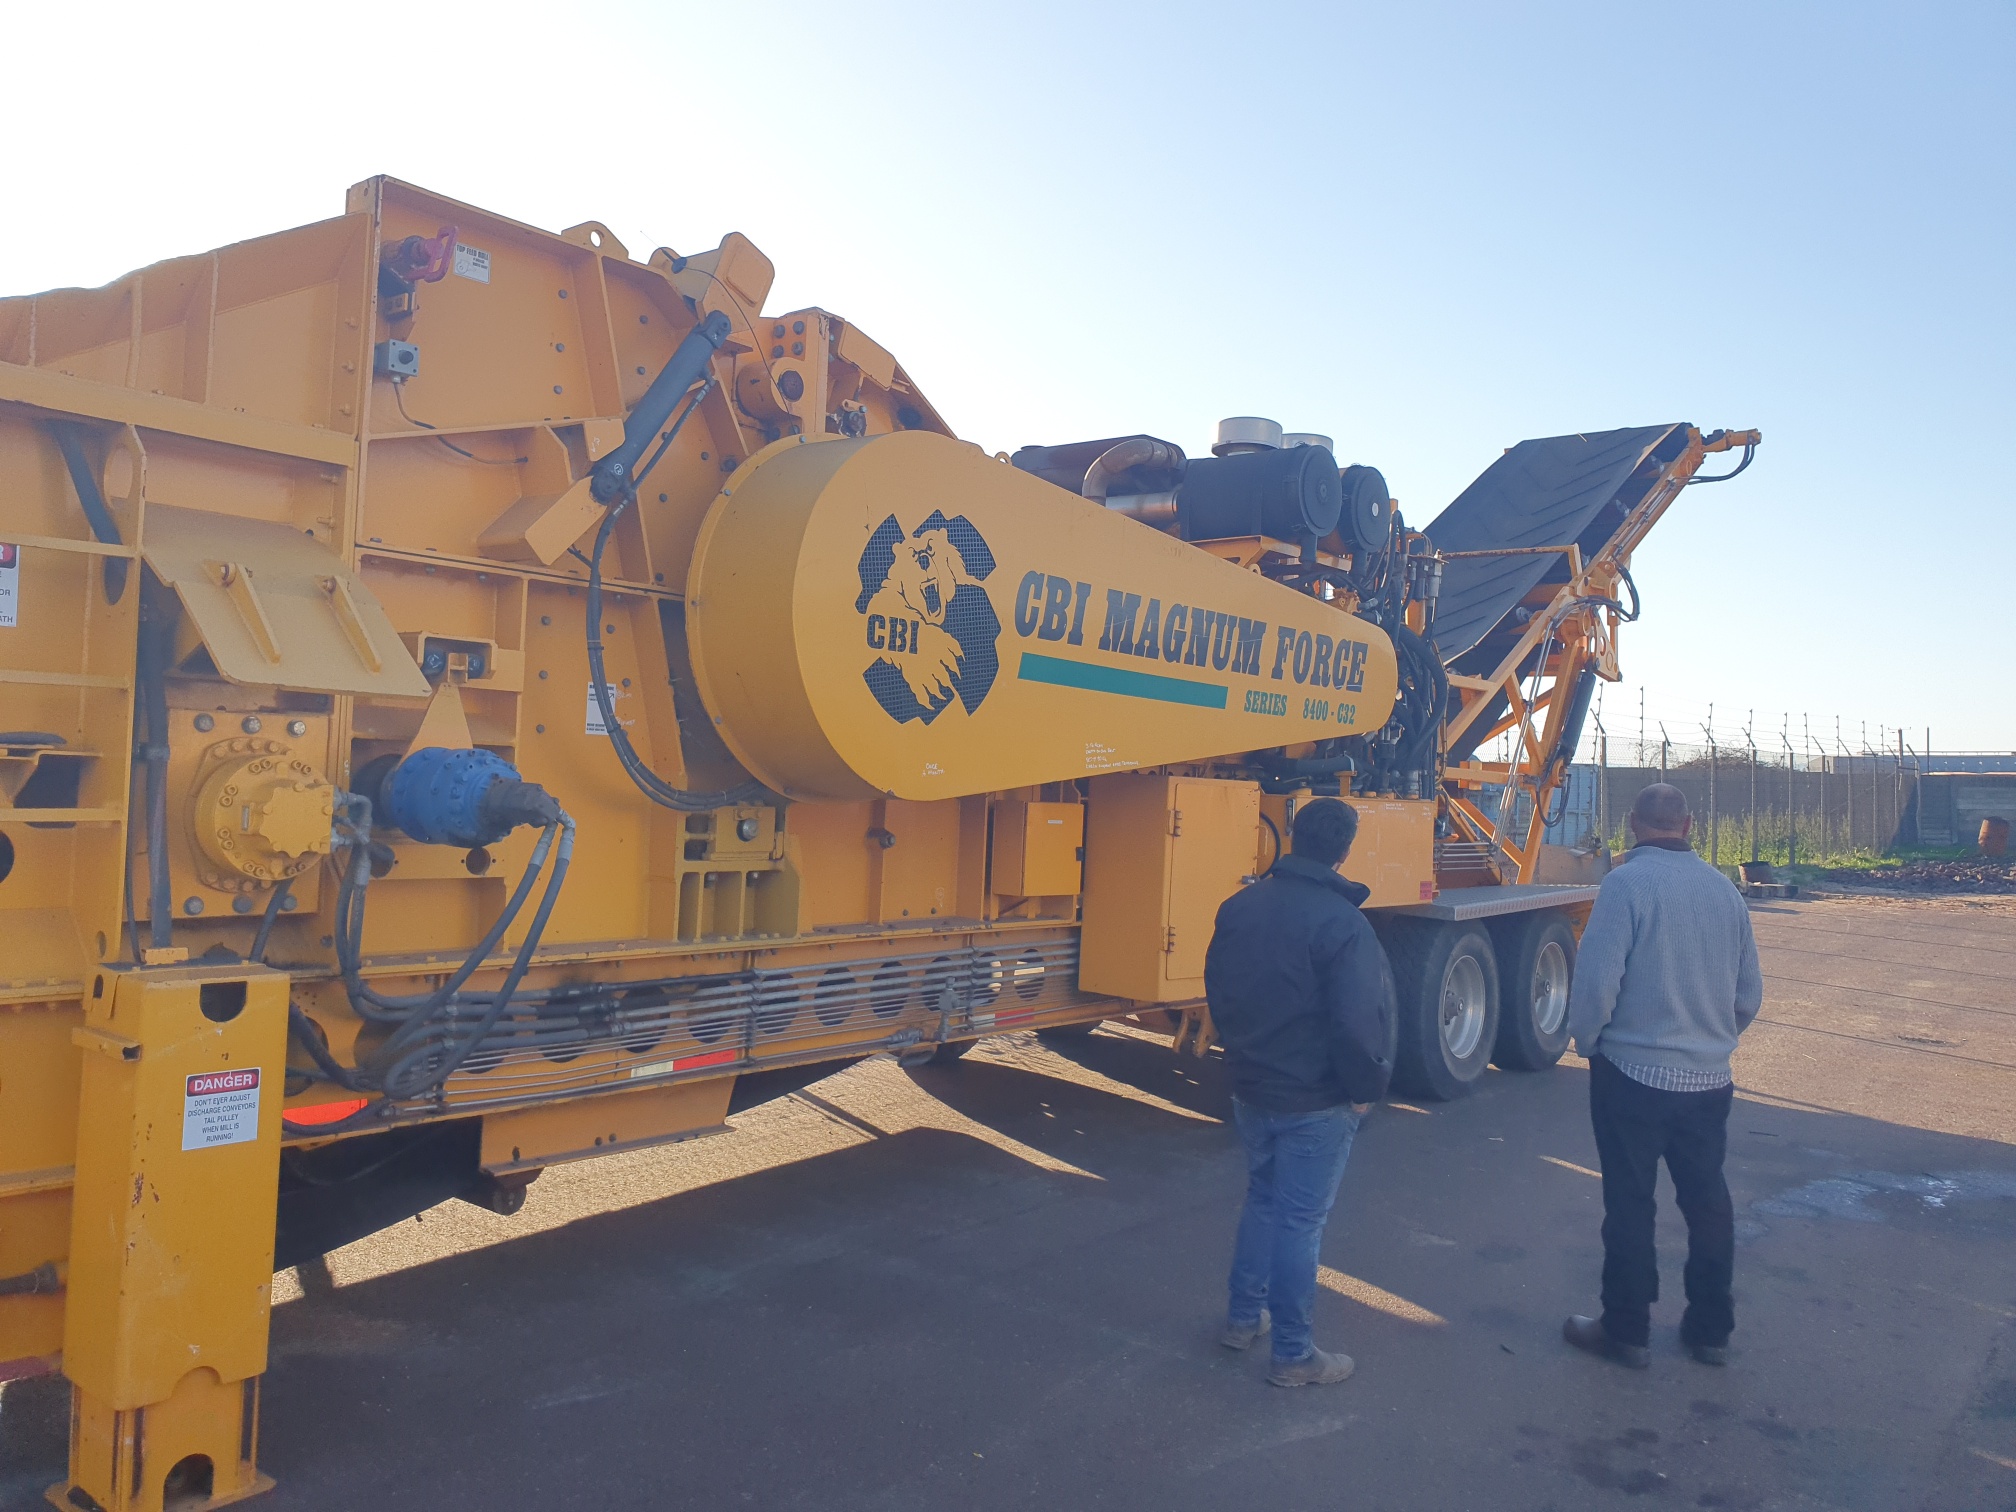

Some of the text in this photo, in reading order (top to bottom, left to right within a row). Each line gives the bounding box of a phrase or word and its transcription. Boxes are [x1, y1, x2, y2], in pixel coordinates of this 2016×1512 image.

[866, 613, 919, 654] CBI
[1014, 570, 1369, 693] CBI MAGNUM FORCE
[1243, 690, 1288, 717] SERIES
[1302, 698, 1329, 722] 8400
[1337, 702, 1356, 725] C32
[194, 1074, 252, 1091] DANGER
[194, 1093, 251, 1107] DON'T EVER ADJUST
[187, 1102, 256, 1117] DISCHARGE CONVEYORS
[217, 1113, 239, 1122] PULLEY
[202, 1125, 219, 1133] WHEN
[220, 1123, 233, 1131] MILL
[205, 1132, 234, 1142] RUNNING!
